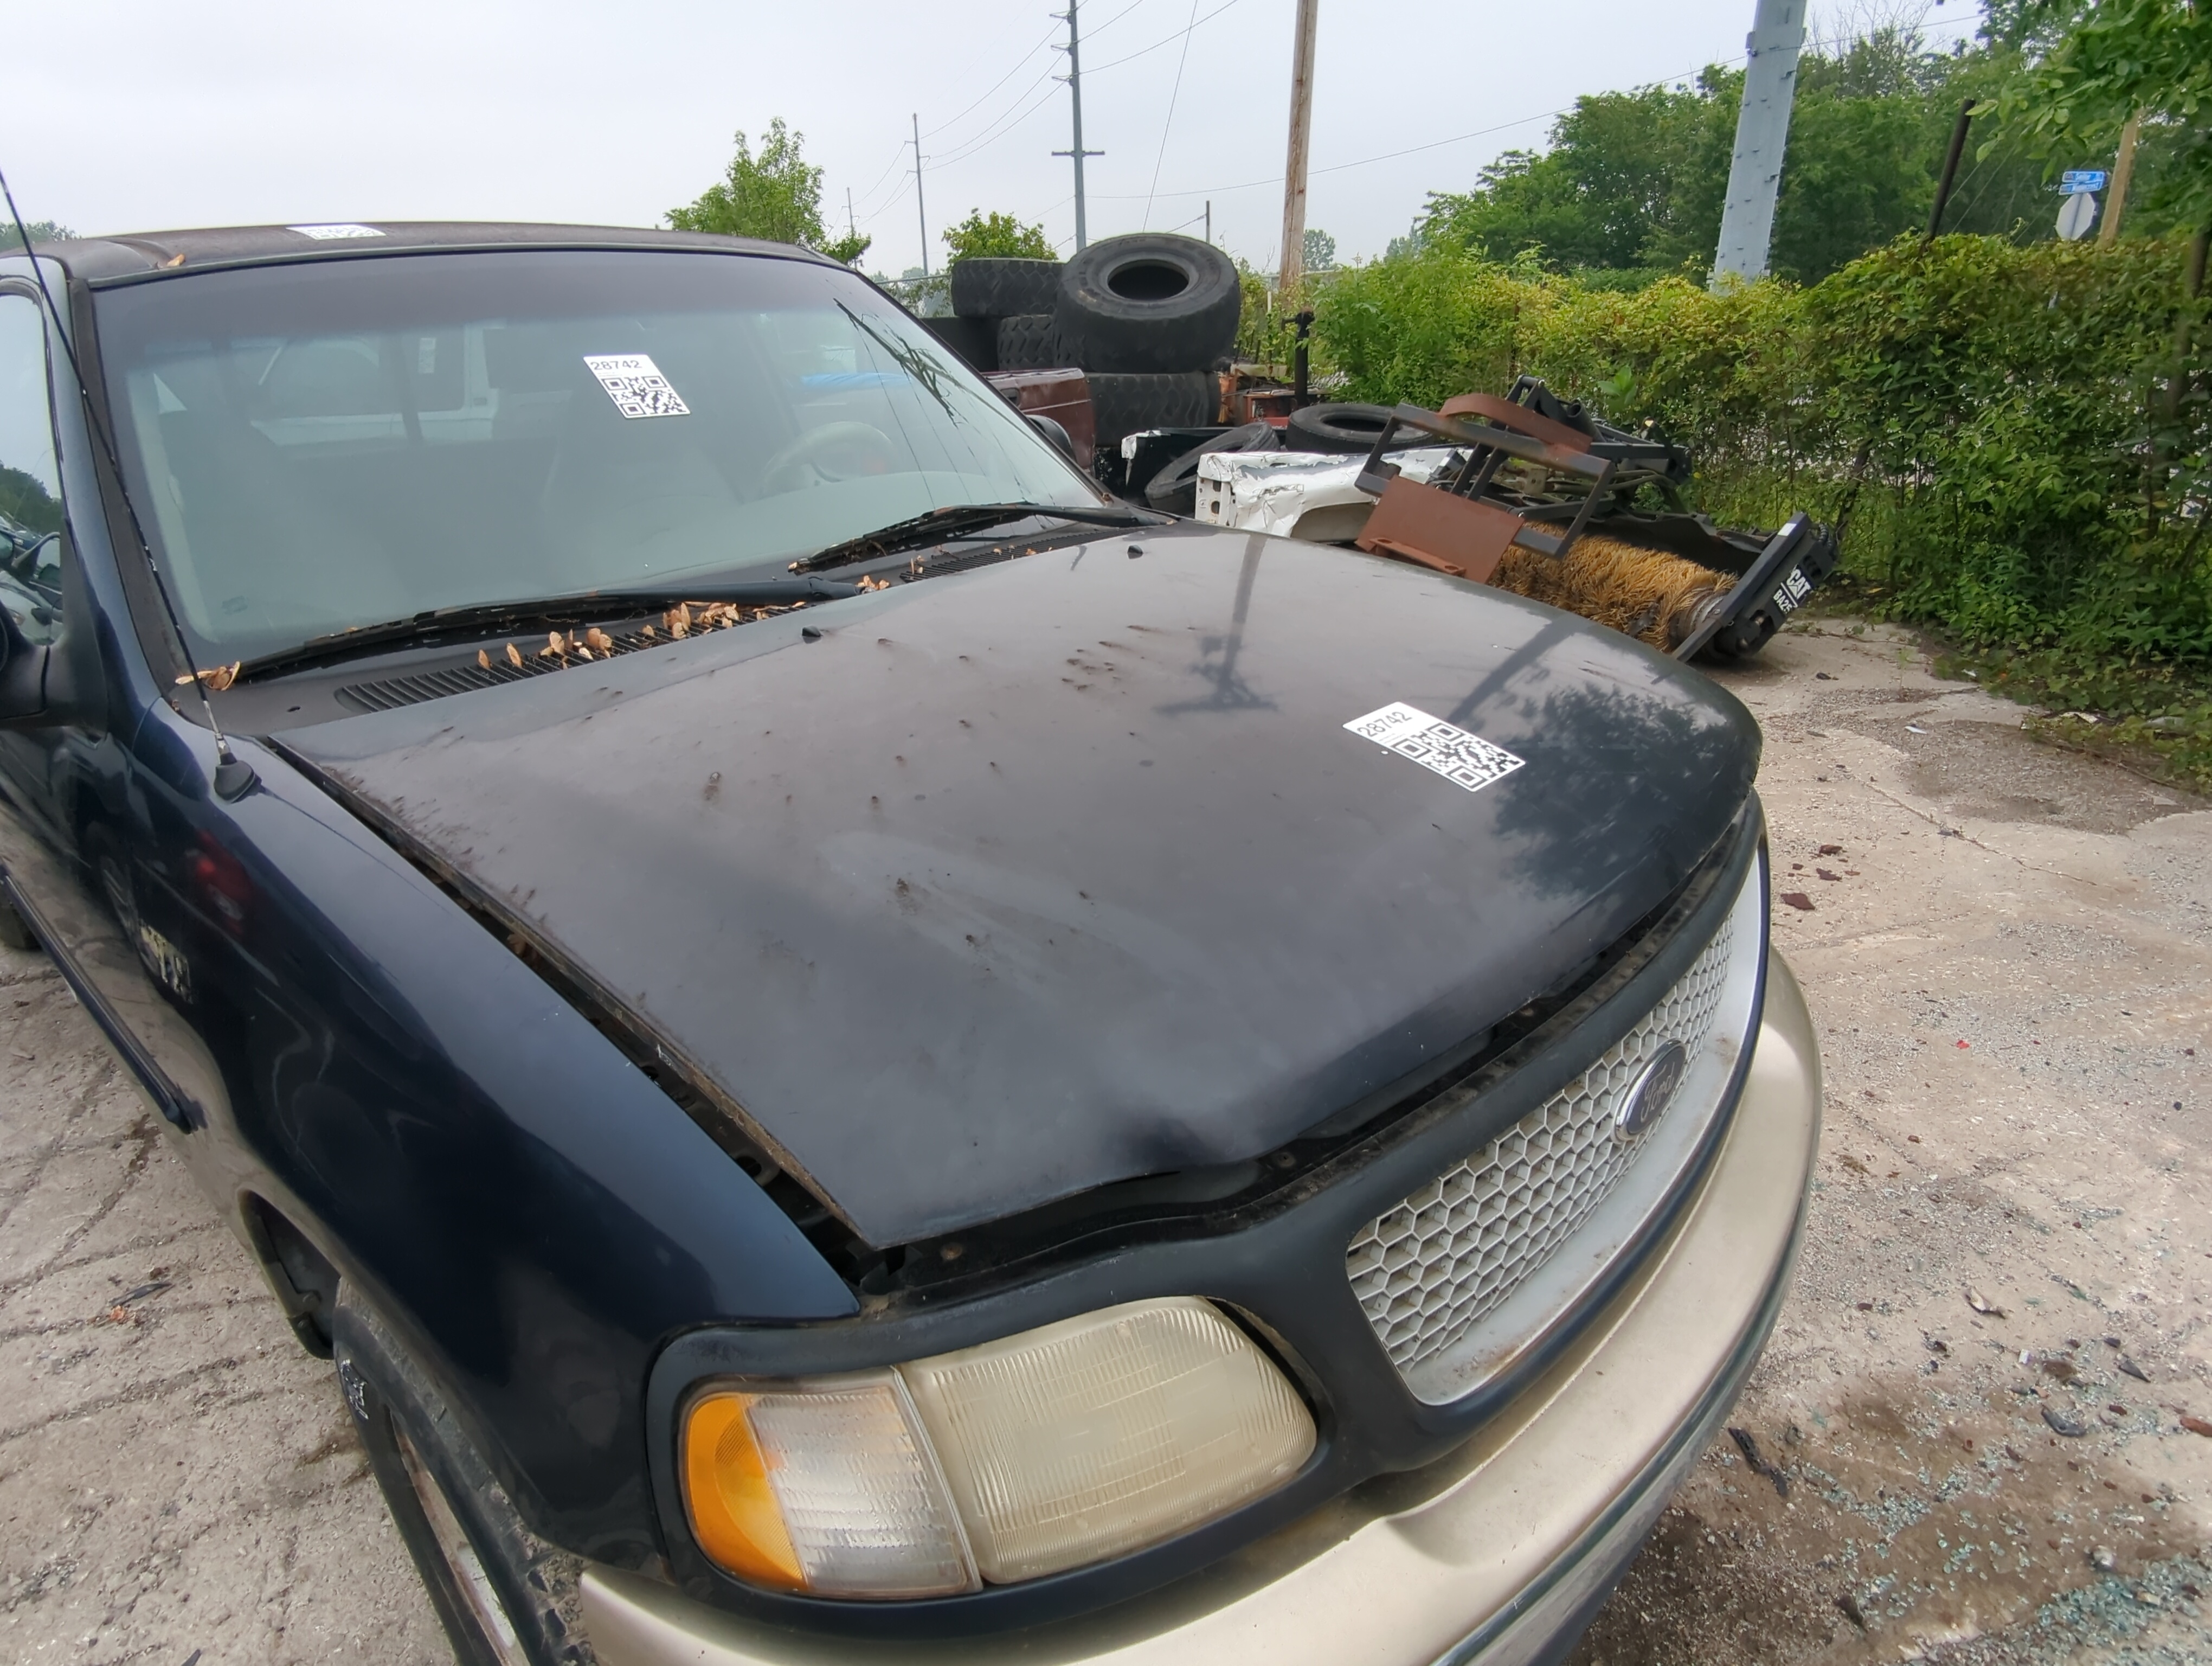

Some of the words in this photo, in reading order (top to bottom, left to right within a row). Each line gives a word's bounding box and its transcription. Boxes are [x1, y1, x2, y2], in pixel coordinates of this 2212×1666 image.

[590, 360, 642, 370] 28742
[1786, 568, 1811, 600] CAT
[1356, 711, 1413, 737] 28742
[1640, 1061, 1675, 1123] Ford
